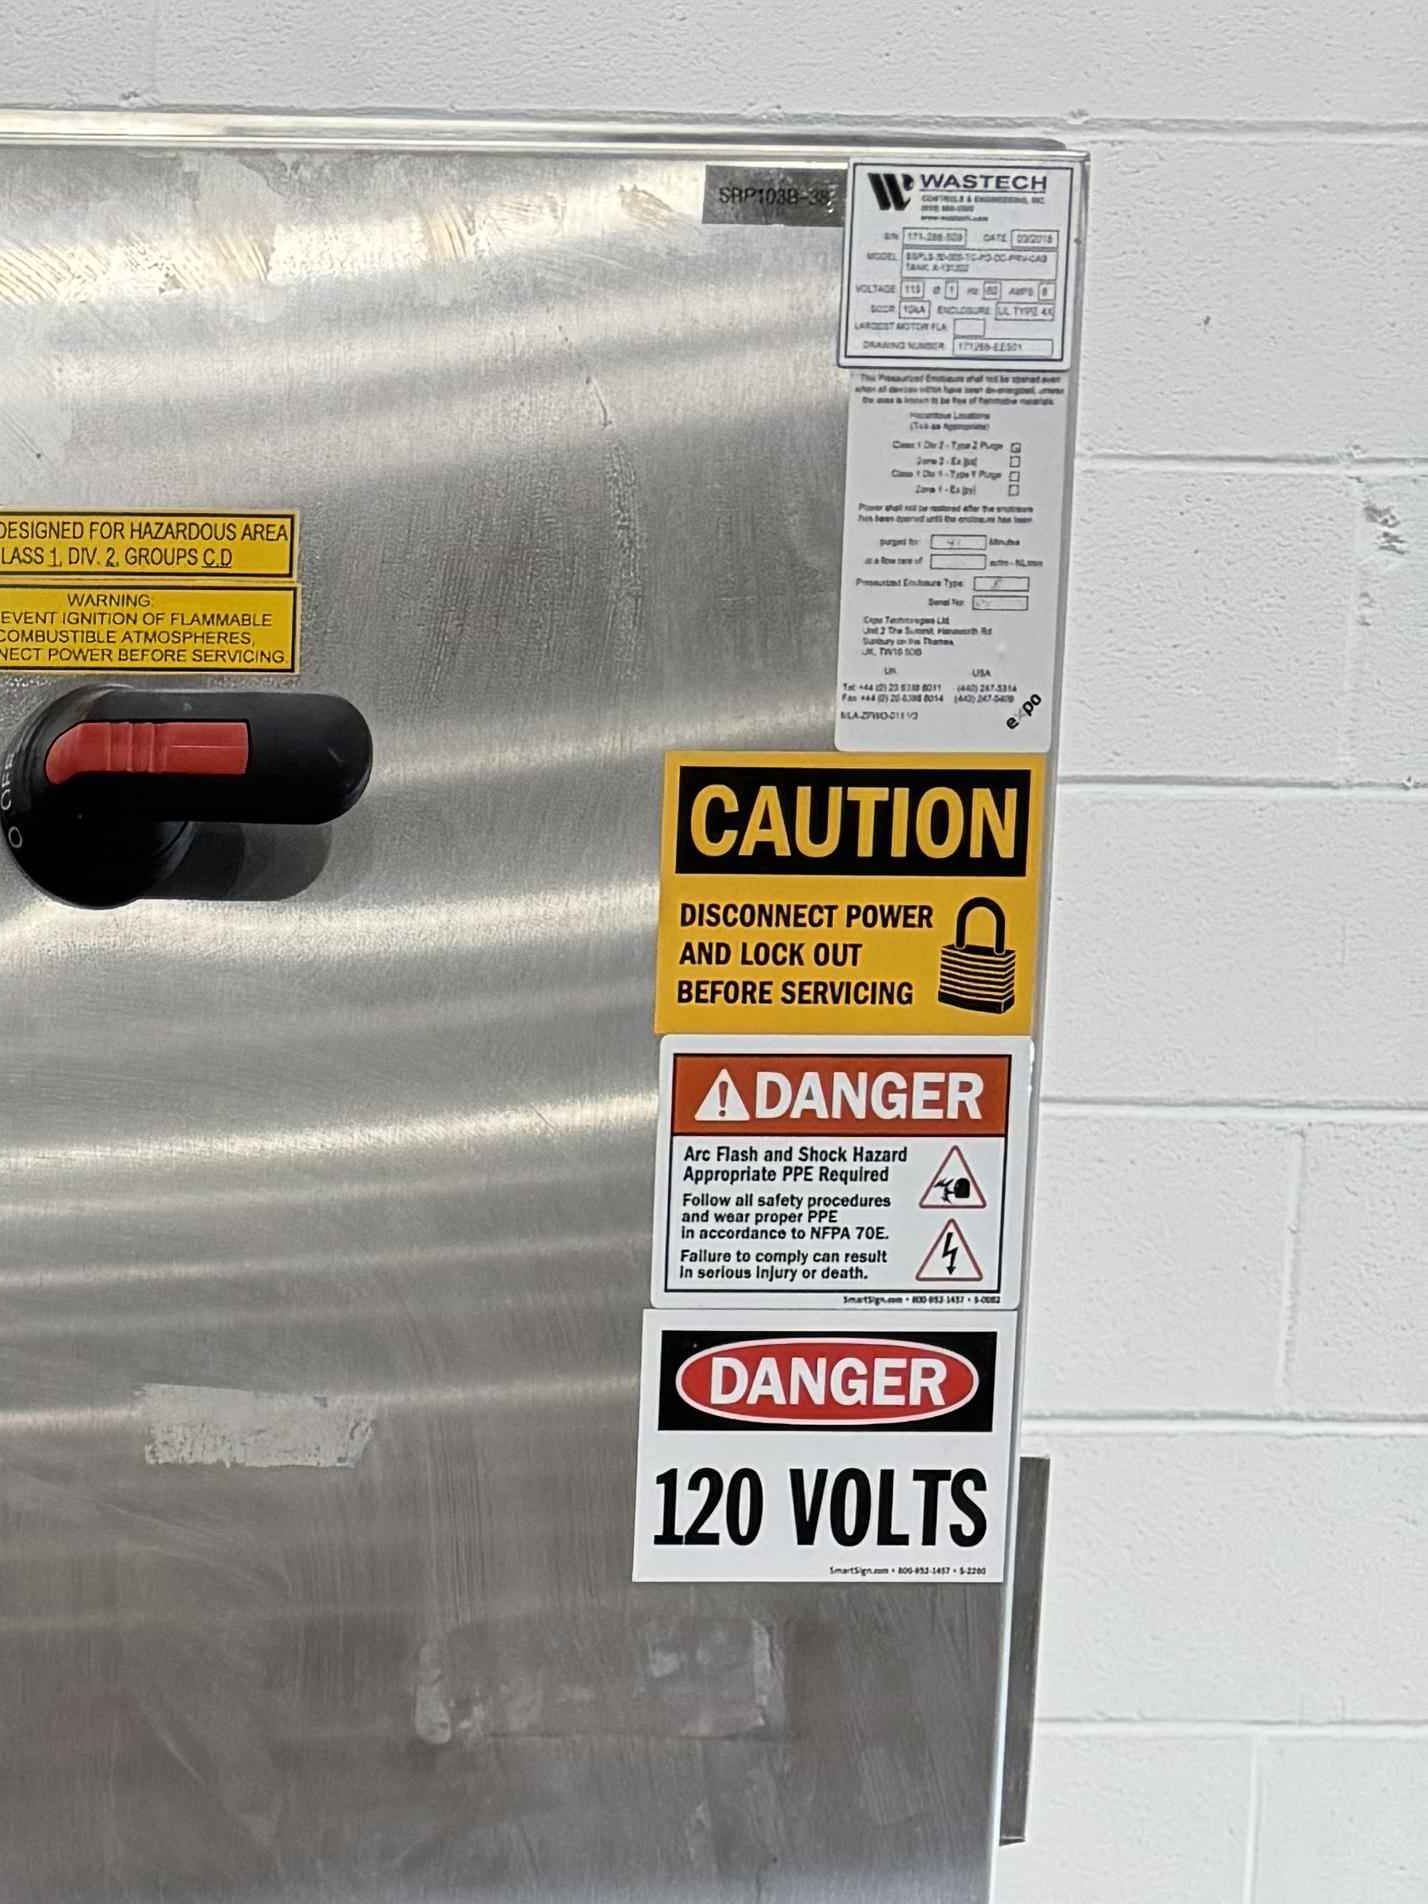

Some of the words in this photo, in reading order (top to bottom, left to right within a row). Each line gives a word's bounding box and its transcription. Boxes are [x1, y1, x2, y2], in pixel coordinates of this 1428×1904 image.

[920, 174, 1048, 191] WASTECH
[89, 522, 125, 541] FOR
[130, 523, 237, 541] HAZARDOUS
[241, 523, 288, 542] AREA
[67, 548, 101, 566] DIV.
[124, 549, 198, 567] GROUPS
[67, 593, 152, 608] WARNING
[62, 611, 138, 626] IGNITION
[142, 612, 165, 626] OF
[170, 612, 273, 627] FLAMMABLE
[120, 630, 255, 647] ATMOSPHERES,
[48, 647, 113, 662] POWER
[118, 648, 187, 663] BEFORE
[192, 648, 287, 664] SERVICING.
[1006, 692, 1043, 730] expo
[690, 783, 1018, 858] CAUTION
[680, 903, 838, 929] DISCONNECT
[846, 904, 933, 929] POWER
[679, 942, 732, 966] AND
[741, 943, 804, 967] LOCK
[813, 943, 862, 967] OUT
[677, 980, 773, 1005] BEFORE
[781, 981, 914, 1006] SERVICING
[755, 1071, 984, 1120] DANGER
[683, 1146, 711, 1162] Arc
[716, 1146, 759, 1162] Flash
[764, 1146, 792, 1163] and
[798, 1146, 847, 1163] Shock
[852, 1146, 908, 1163] Hazard
[683, 1166, 777, 1183] Appropriate
[782, 1167, 814, 1182] PPE
[819, 1167, 889, 1184] Required
[682, 1194, 730, 1208] Follow
[736, 1194, 754, 1207] all
[757, 1194, 803, 1210] safety
[808, 1194, 891, 1210] procedures
[681, 1210, 709, 1223] and
[714, 1212, 750, 1223] wear
[755, 1212, 803, 1227] proper
[807, 1210, 838, 1223] PPE
[681, 1226, 696, 1240] in
[700, 1226, 786, 1240] accordance
[792, 1227, 806, 1240] to
[810, 1226, 851, 1240] NFPA
[855, 1227, 890, 1240] 70E.
[680, 1249, 732, 1263] Failure
[736, 1251, 751, 1263] to
[756, 1250, 808, 1266] comply
[812, 1252, 840, 1264] can
[844, 1250, 888, 1264] result
[679, 1266, 693, 1279] in
[697, 1266, 751, 1279] serious
[756, 1266, 797, 1282] injury
[801, 1269, 817, 1280] or
[821, 1266, 869, 1280] death.
[710, 1356, 948, 1406] DANGER
[653, 1466, 764, 1546] 120
[789, 1467, 988, 1547] VOLTS
[829, 1566, 889, 1577] SmartSign.com
